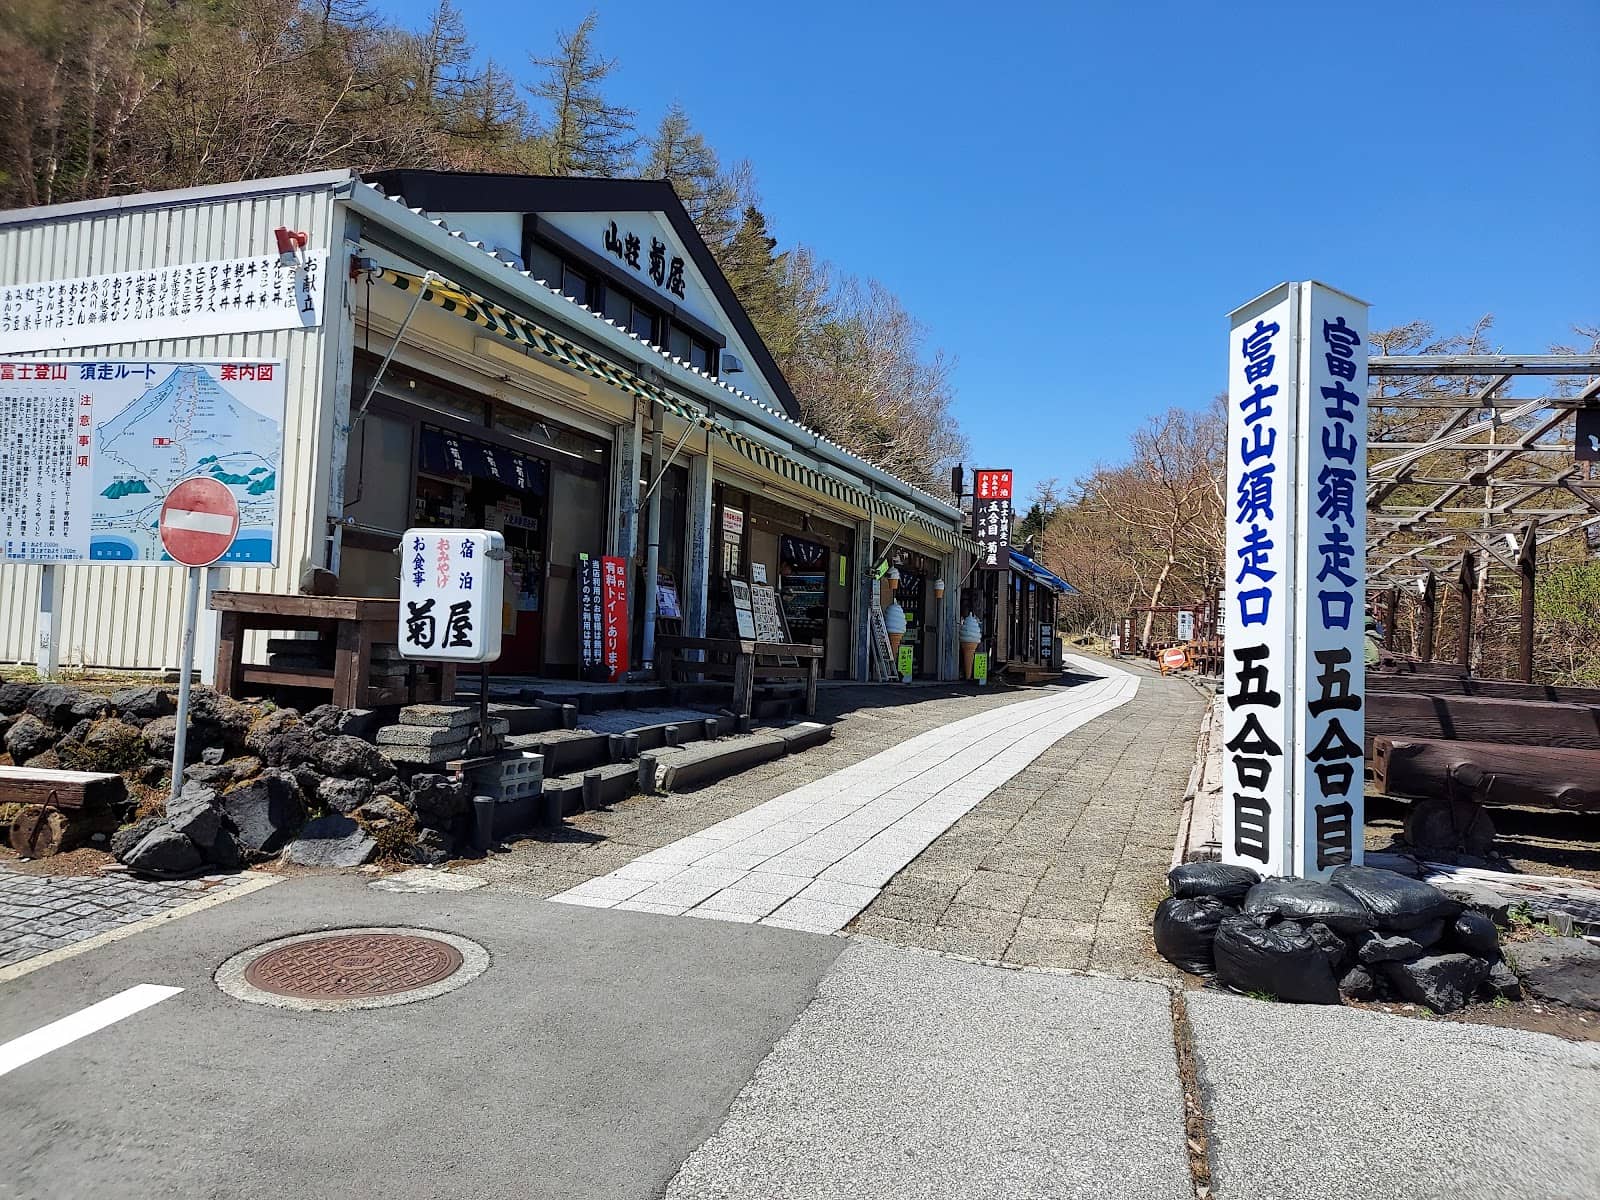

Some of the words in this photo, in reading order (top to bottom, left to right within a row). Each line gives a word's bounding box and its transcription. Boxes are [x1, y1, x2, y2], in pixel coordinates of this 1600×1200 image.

[207, 266, 218, 312] カレーライス
[301, 256, 318, 313] お献立
[649, 236, 685, 300] 菊屋
[122, 276, 132, 320] ラーメン
[0, 363, 67, 381] 富士登山
[80, 363, 156, 381] 須走ルート
[220, 362, 273, 381] 案内図
[78, 394, 92, 467] 注意事項
[1235, 320, 1280, 628] 富士山須走口
[1316, 316, 1361, 631] 富士山須走口
[987, 500, 1000, 536] 五合目
[999, 500, 1009, 547] 富士山須走口
[412, 536, 426, 588] お食事
[437, 537, 450, 589] おみやげ
[459, 538, 475, 590] 宿泊
[986, 541, 998, 566] 菊屋
[406, 598, 473, 650] 菊屋
[605, 561, 618, 676] 有料トイレあります
[1225, 643, 1283, 864] 五合目
[1306, 647, 1363, 871] 五合目
